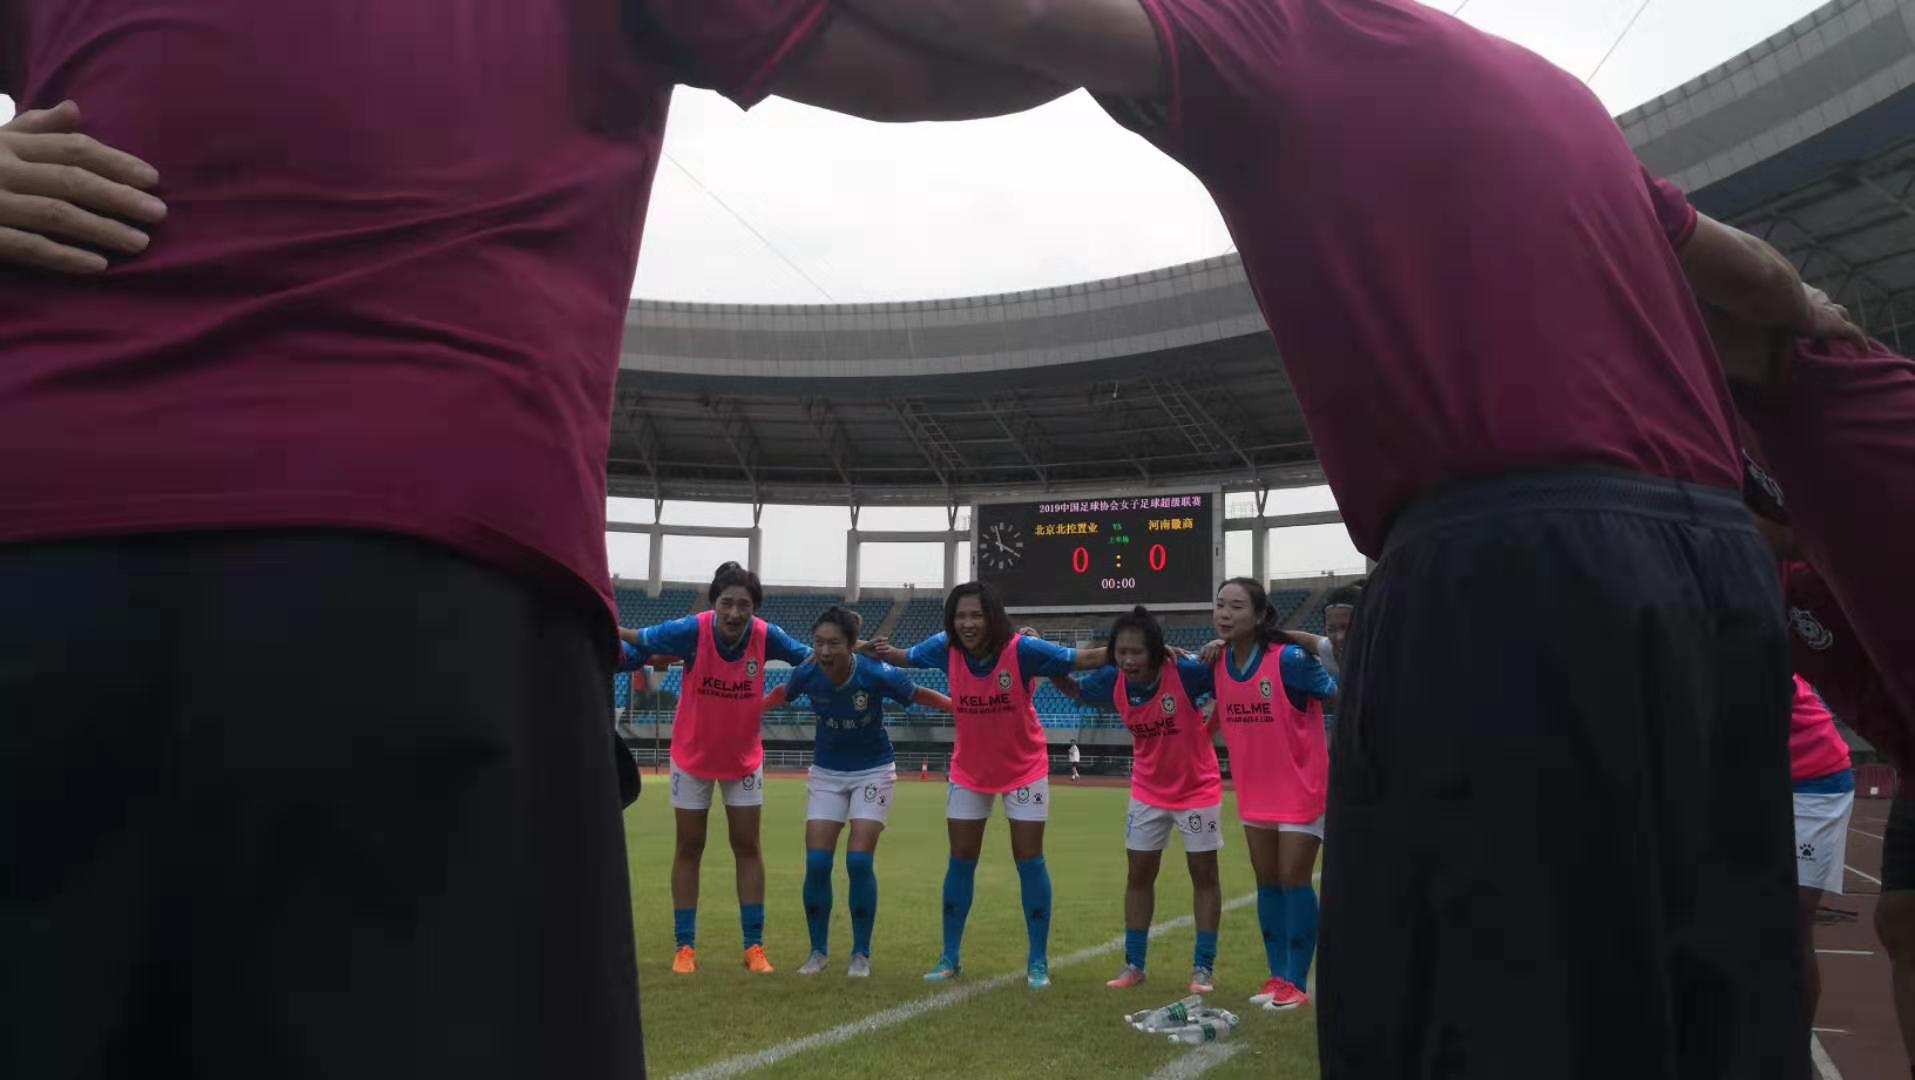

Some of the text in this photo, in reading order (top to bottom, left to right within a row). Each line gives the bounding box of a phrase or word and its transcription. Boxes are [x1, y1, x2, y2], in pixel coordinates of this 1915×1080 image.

[1039, 496, 1202, 513] 2019中国足球协会女子足球超级联赛
[1035, 522, 1099, 536] 北京北控置业
[1072, 546, 1089, 574] 0
[1149, 543, 1166, 572] 0
[1101, 577, 1136, 589] 00:00
[702, 677, 753, 692] KELME
[959, 693, 1011, 707] KELME
[1226, 703, 1272, 715] KELME
